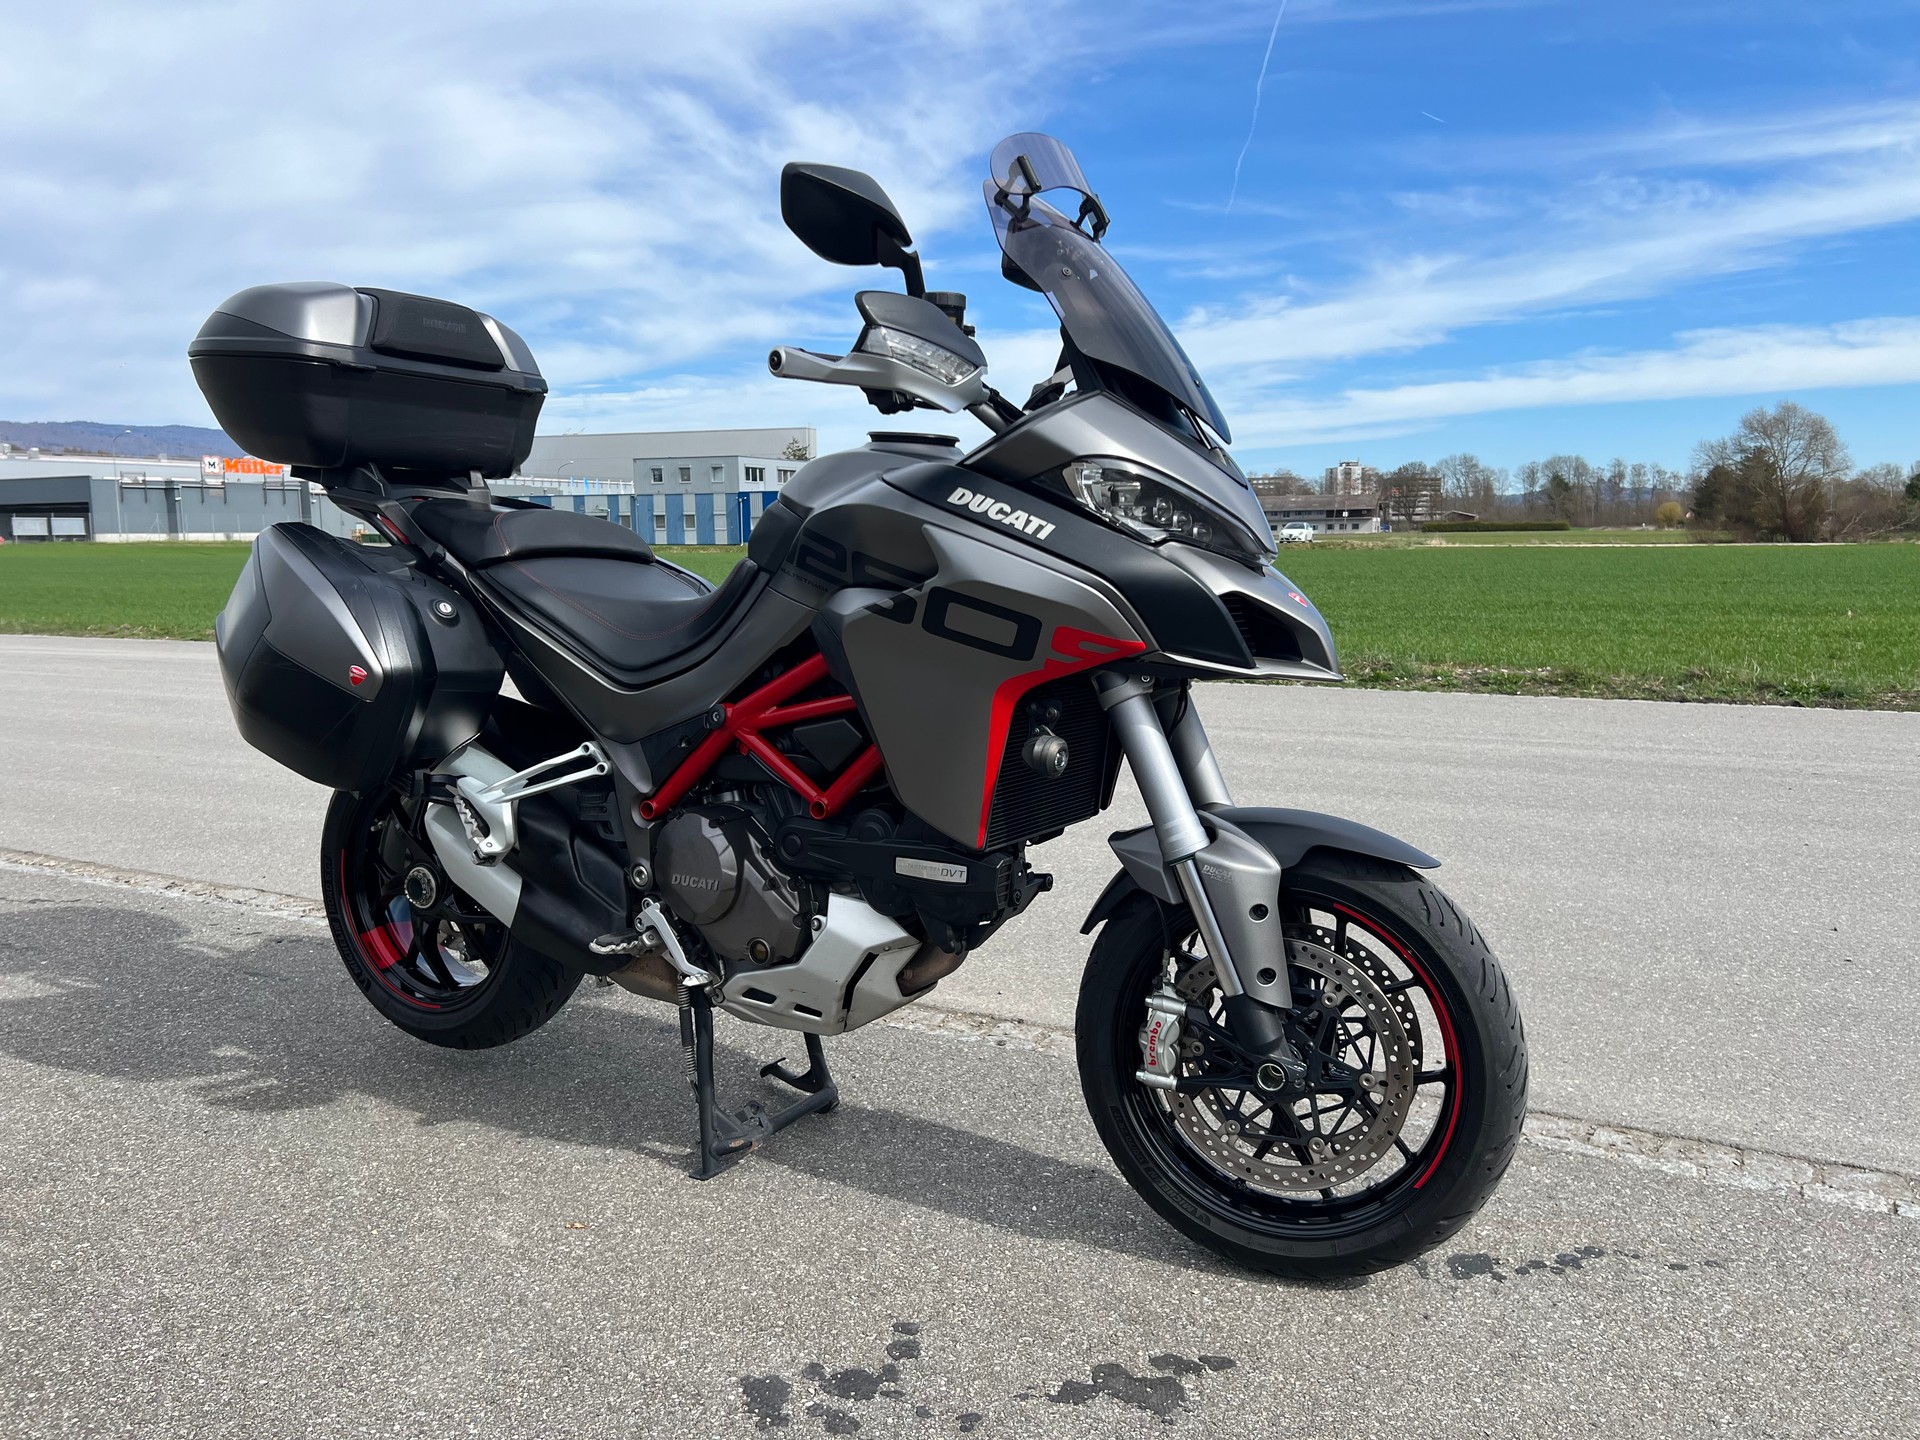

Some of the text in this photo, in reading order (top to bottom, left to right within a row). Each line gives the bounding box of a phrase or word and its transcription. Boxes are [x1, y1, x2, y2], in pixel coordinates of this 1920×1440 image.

[223, 458, 284, 475] Müller
[947, 487, 1057, 541] DUCATI
[671, 874, 720, 891] DUCATI
[940, 868, 966, 878] DVT
[325, 884, 336, 912] ROAD
[332, 921, 362, 974] MICHELIN
[1148, 1021, 1161, 1067] brembo
[1147, 1169, 1195, 1213] MICHELIN
